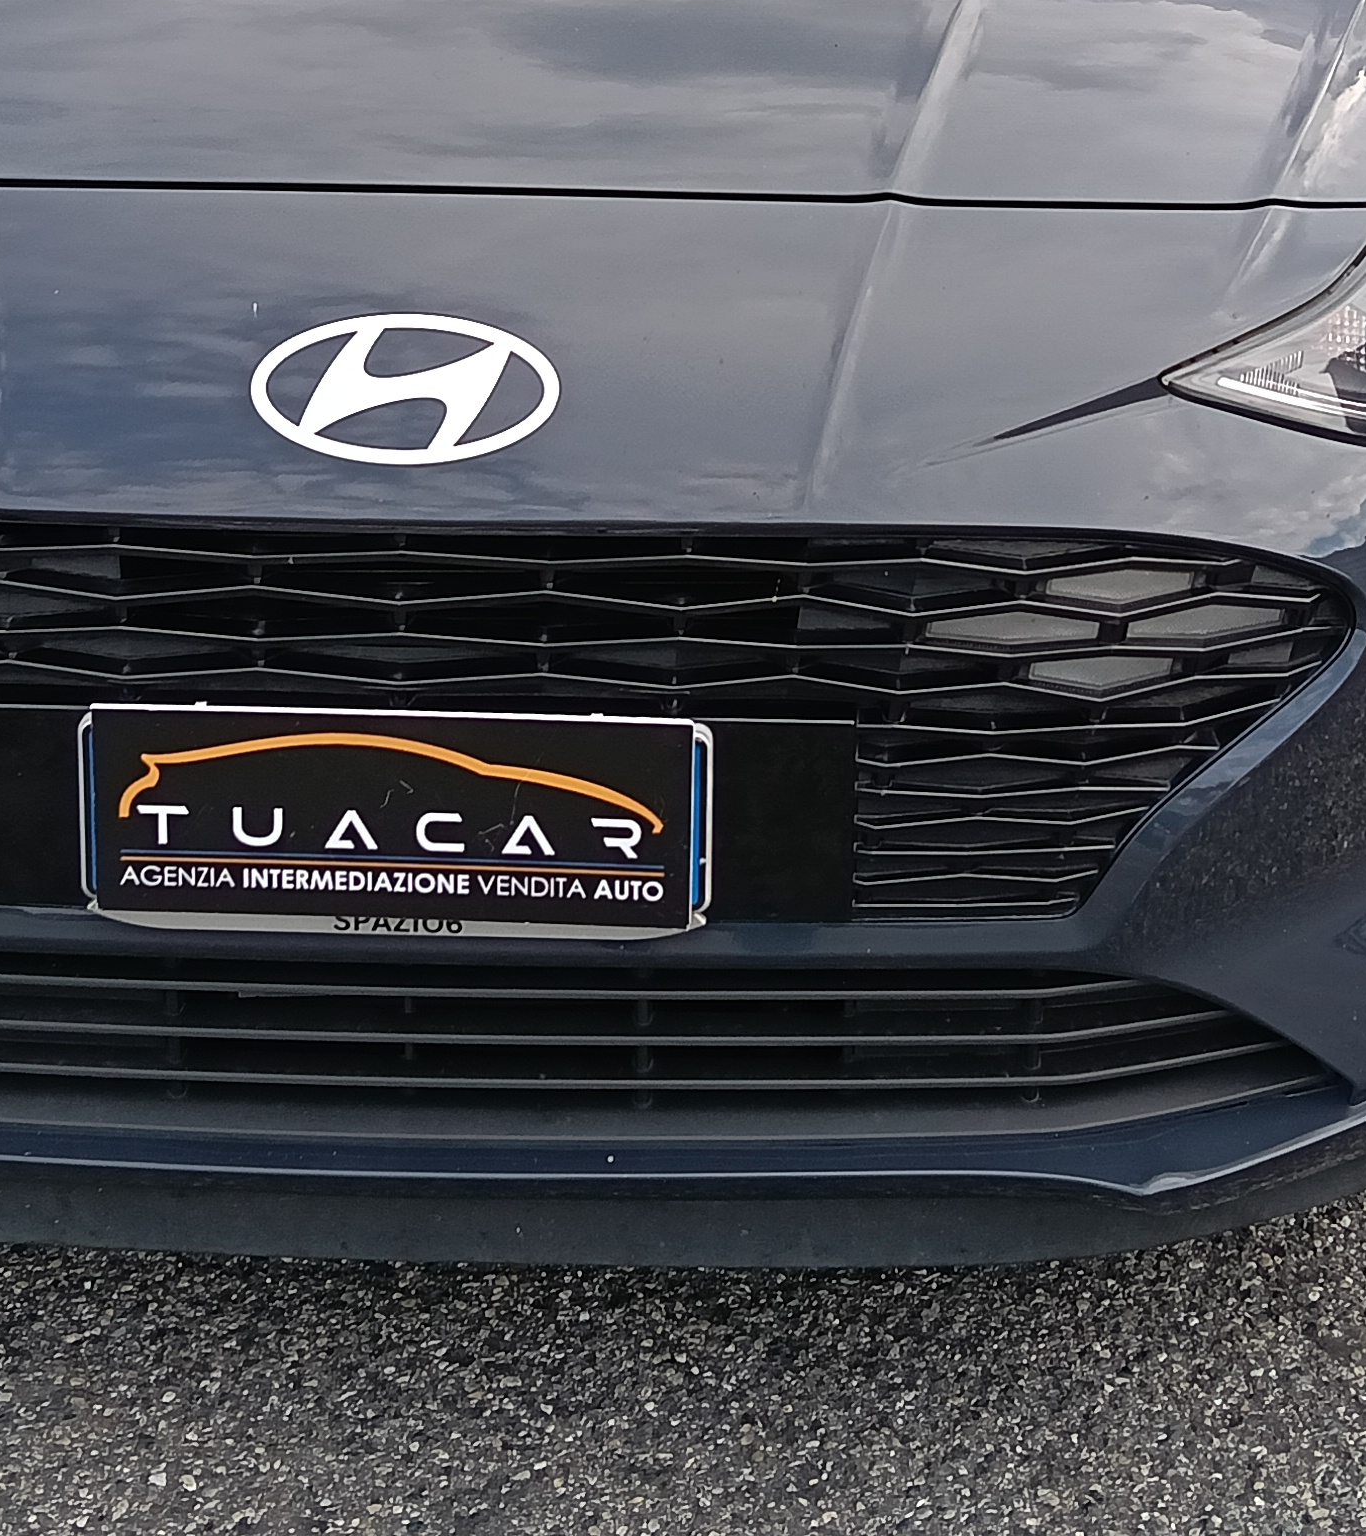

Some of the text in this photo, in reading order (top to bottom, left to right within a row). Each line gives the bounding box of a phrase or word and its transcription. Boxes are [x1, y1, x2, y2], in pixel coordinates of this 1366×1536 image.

[119, 864, 664, 902] AGENZIA INTERMEDIAZIONE VENDITA AUTO
